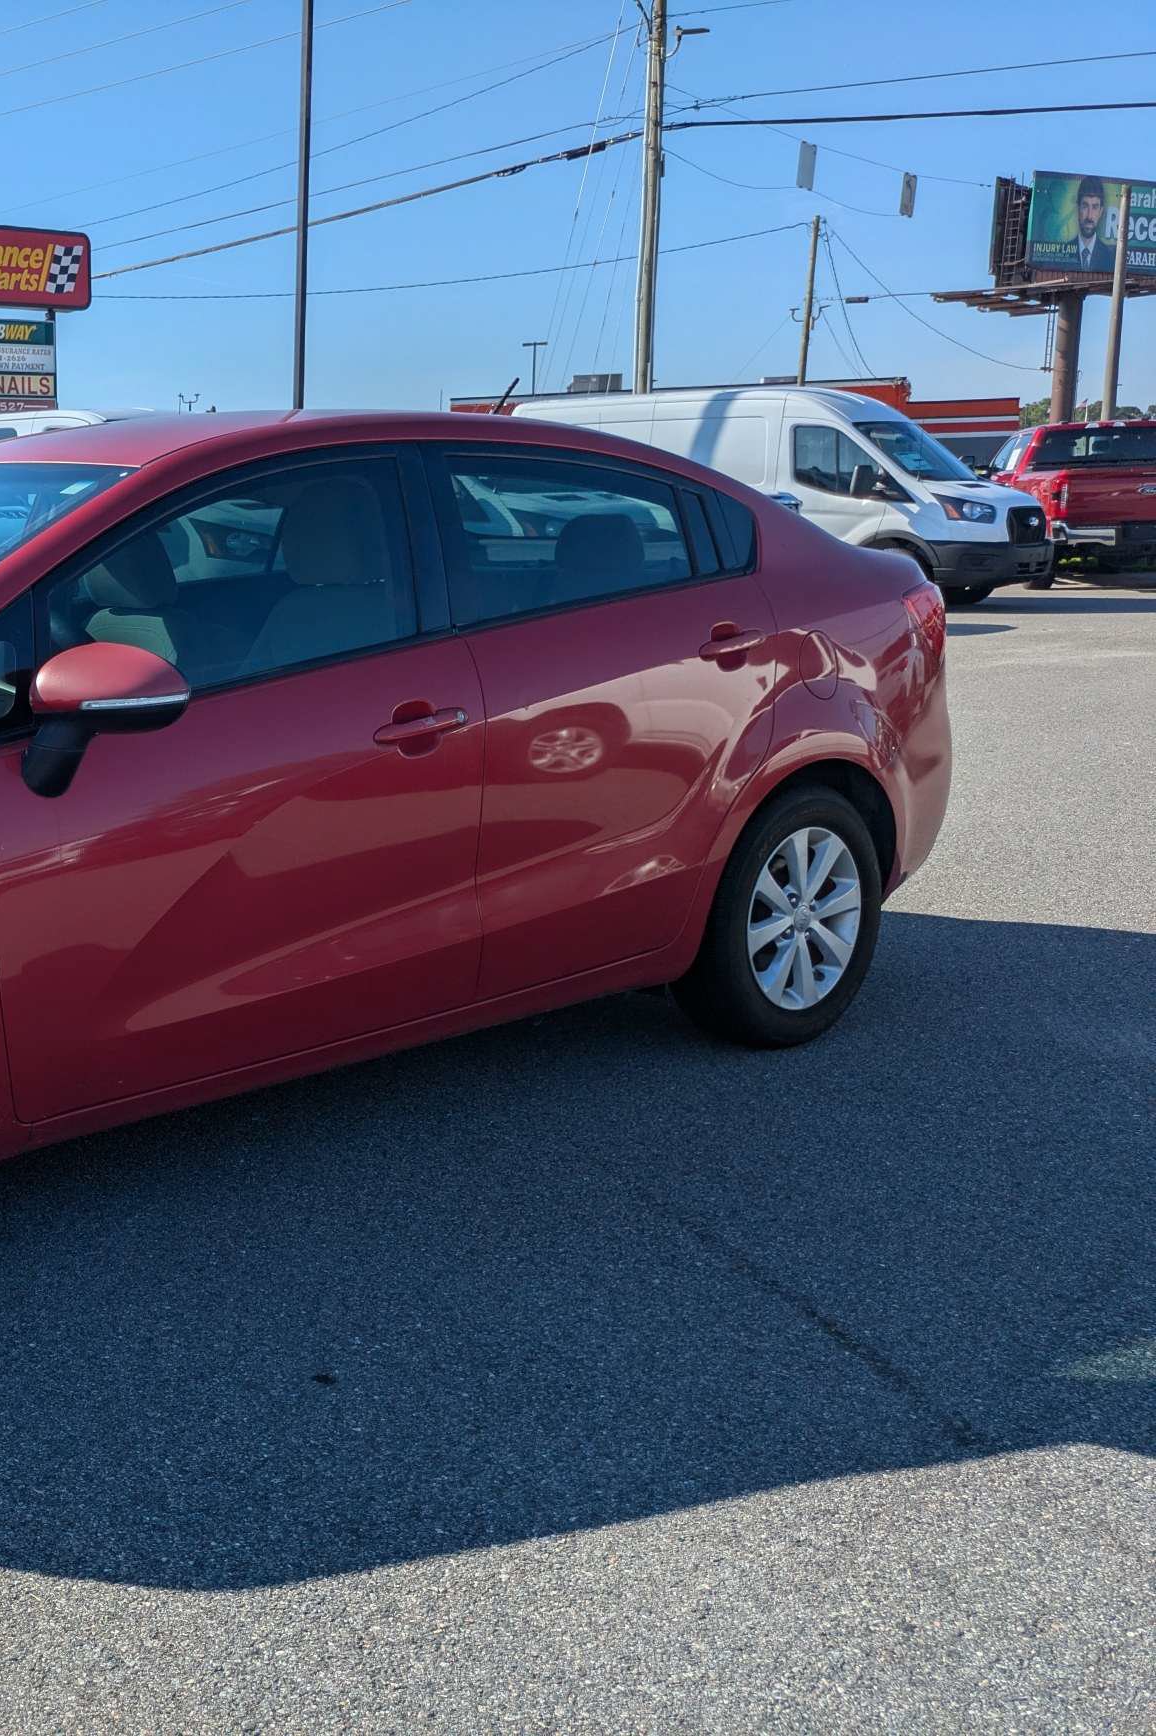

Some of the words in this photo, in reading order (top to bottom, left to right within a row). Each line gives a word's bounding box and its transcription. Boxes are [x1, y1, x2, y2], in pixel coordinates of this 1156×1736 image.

[1130, 188, 1156, 208] arah
[1033, 243, 1060, 253] INJURY
[1062, 244, 1078, 254] LAW
[11, 363, 45, 371] PAYMENT
